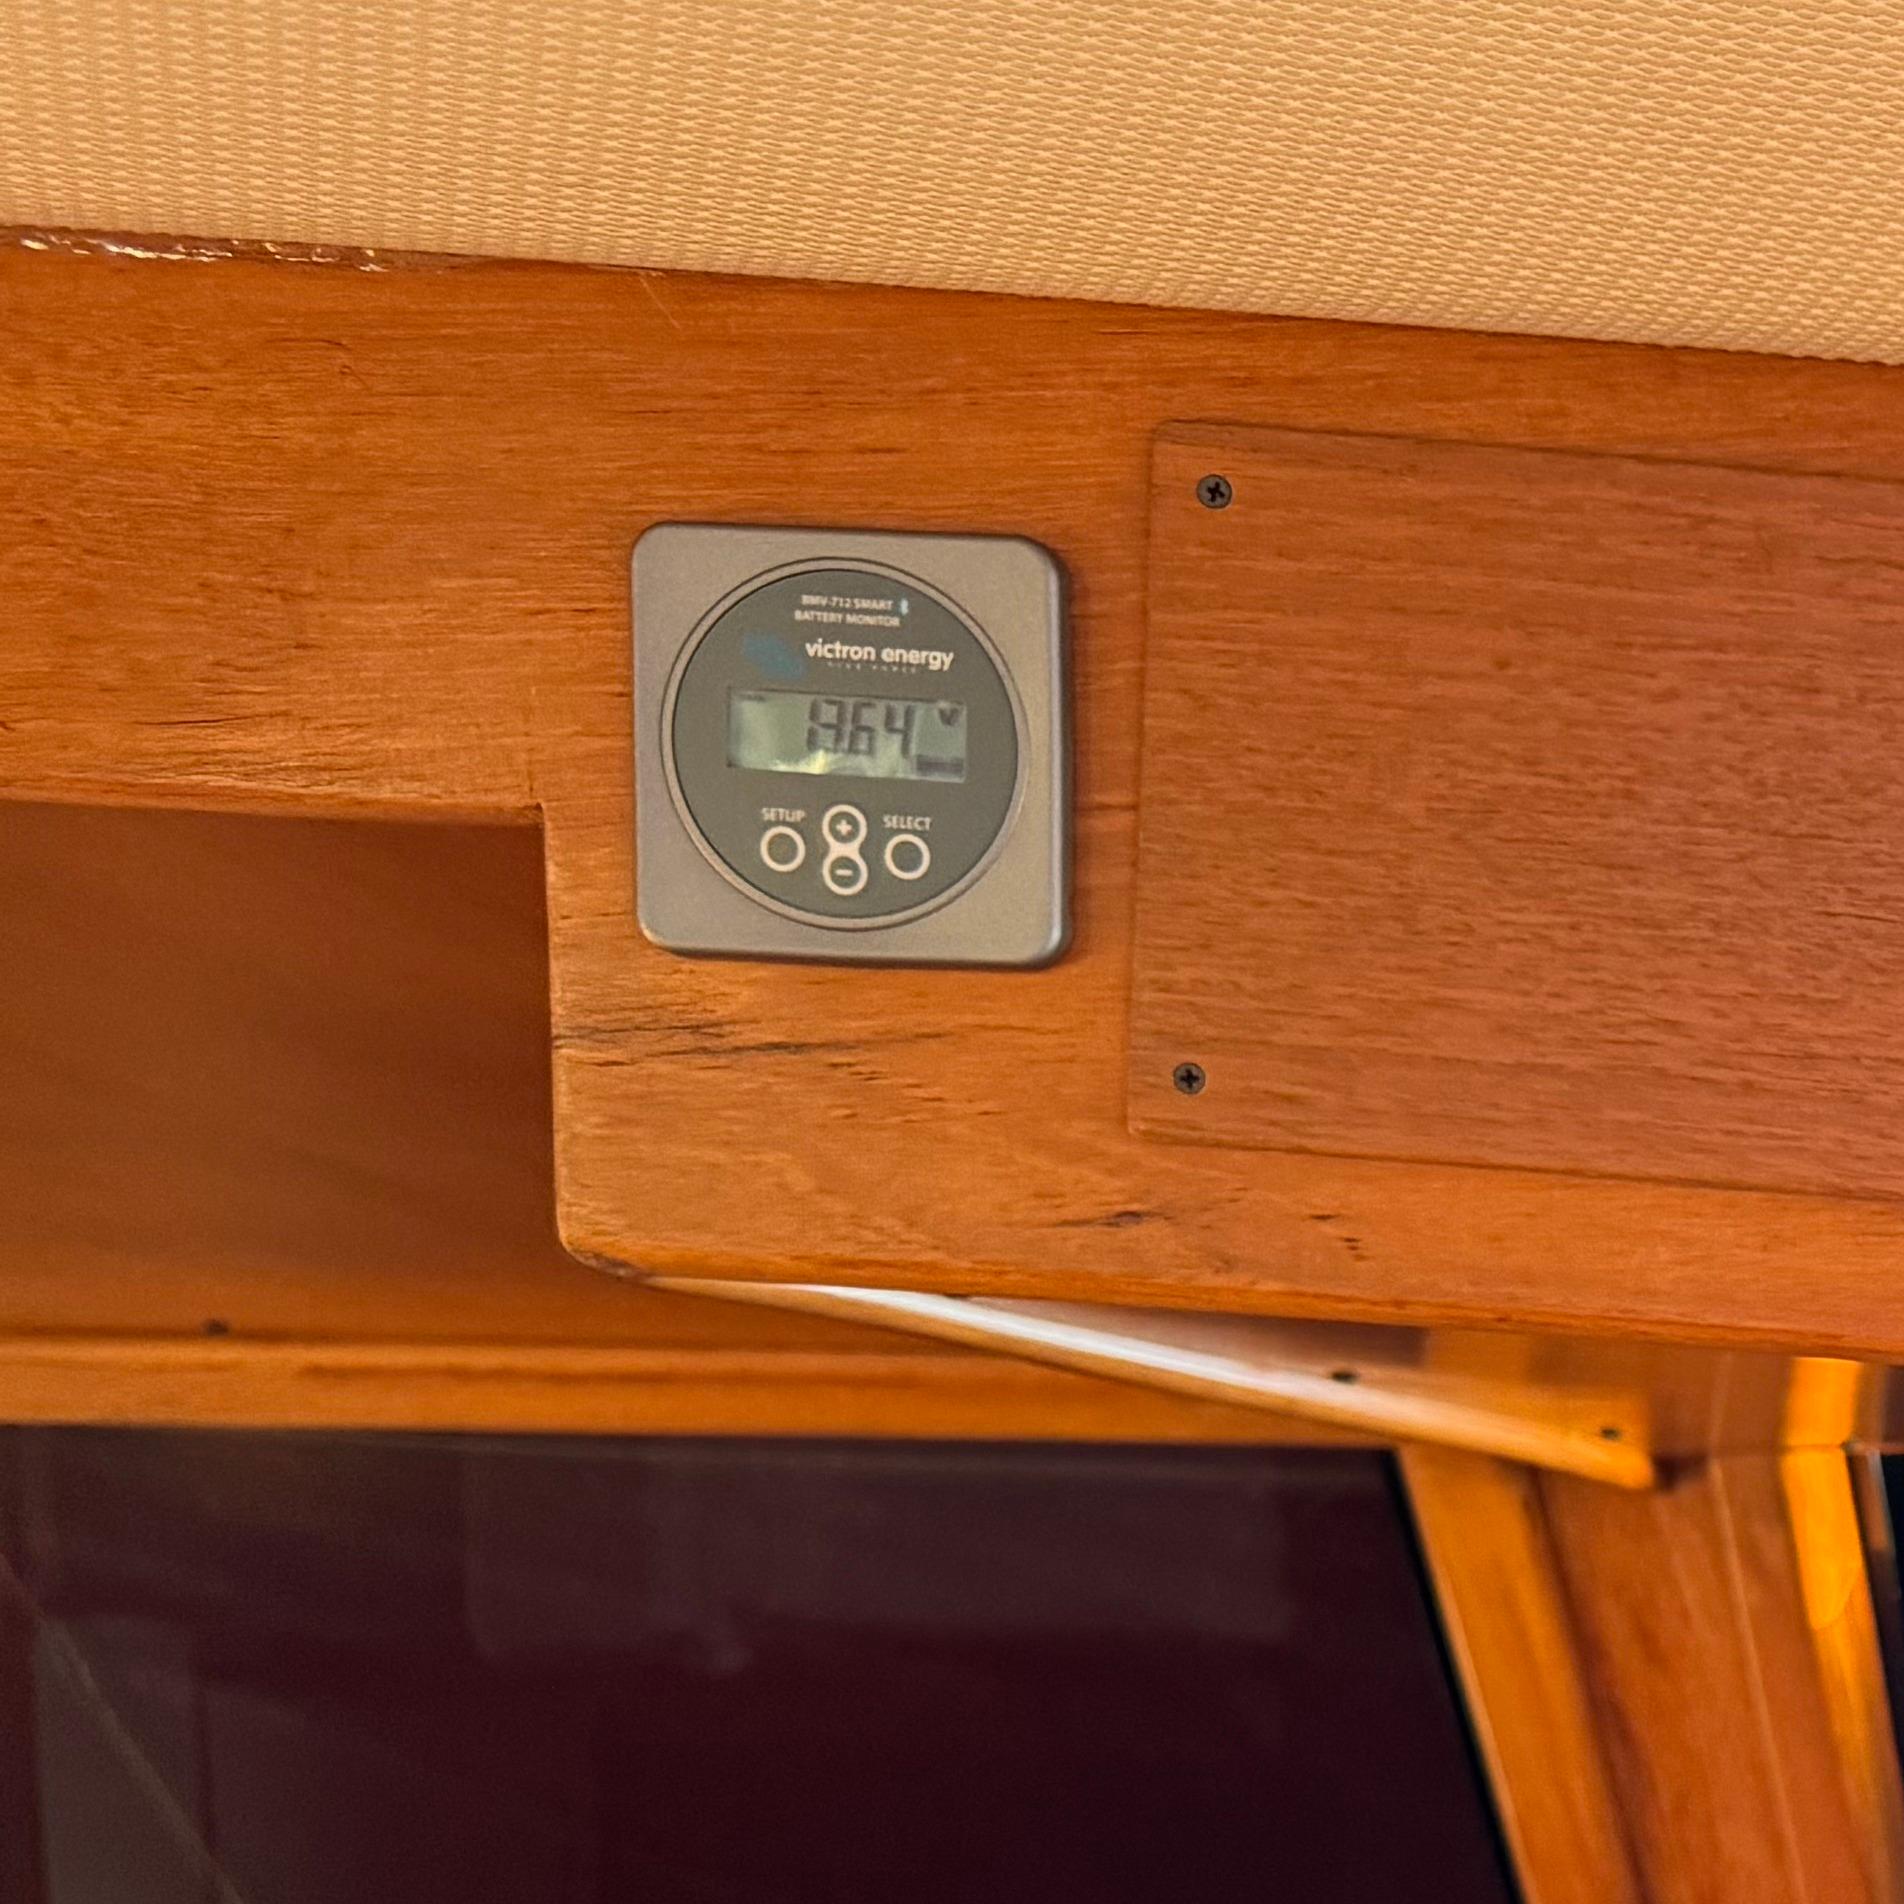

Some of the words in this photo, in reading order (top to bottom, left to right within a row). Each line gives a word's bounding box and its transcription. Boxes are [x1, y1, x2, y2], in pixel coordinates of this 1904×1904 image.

[853, 598, 893, 611] SMART
[794, 609, 843, 624] BATTERY
[845, 613, 901, 627] MONITOR
[805, 638, 876, 660] victron
[880, 647, 955, 671] energy
[762, 807, 806, 823] SETUP
[882, 814, 932, 831] SELECT
